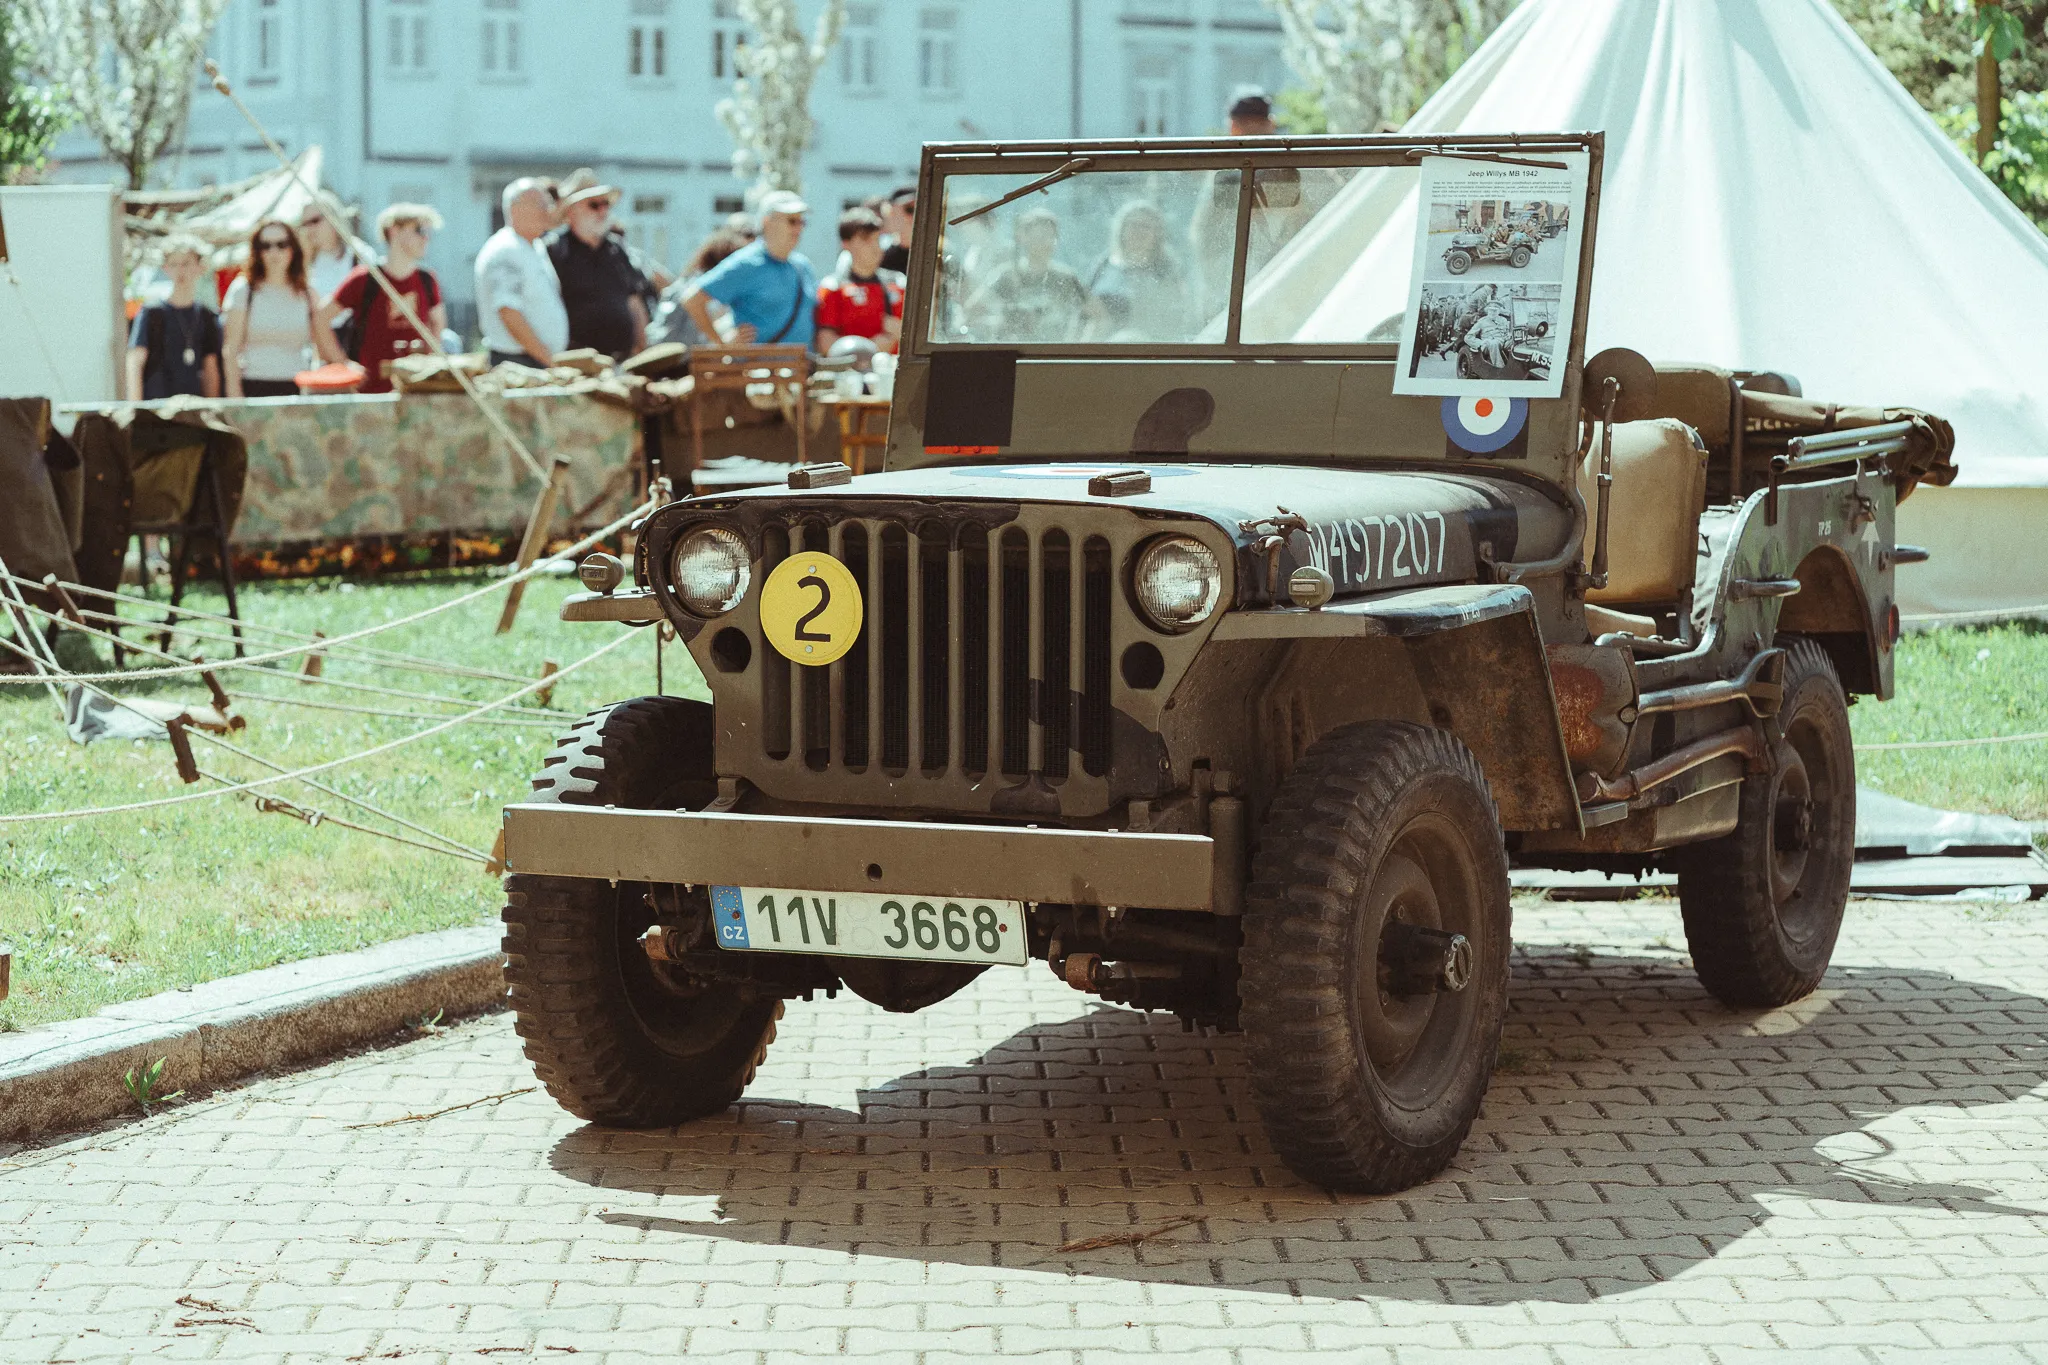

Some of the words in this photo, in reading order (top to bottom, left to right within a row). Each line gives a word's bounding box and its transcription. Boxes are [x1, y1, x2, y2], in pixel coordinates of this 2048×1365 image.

[1468, 170, 1485, 178] Jeep
[1486, 170, 1507, 179] Willys
[1307, 511, 1446, 584] M497207
[795, 576, 831, 642] 2
[722, 925, 745, 941] CZ
[756, 895, 837, 946] 11V
[880, 900, 1002, 954] 3668
